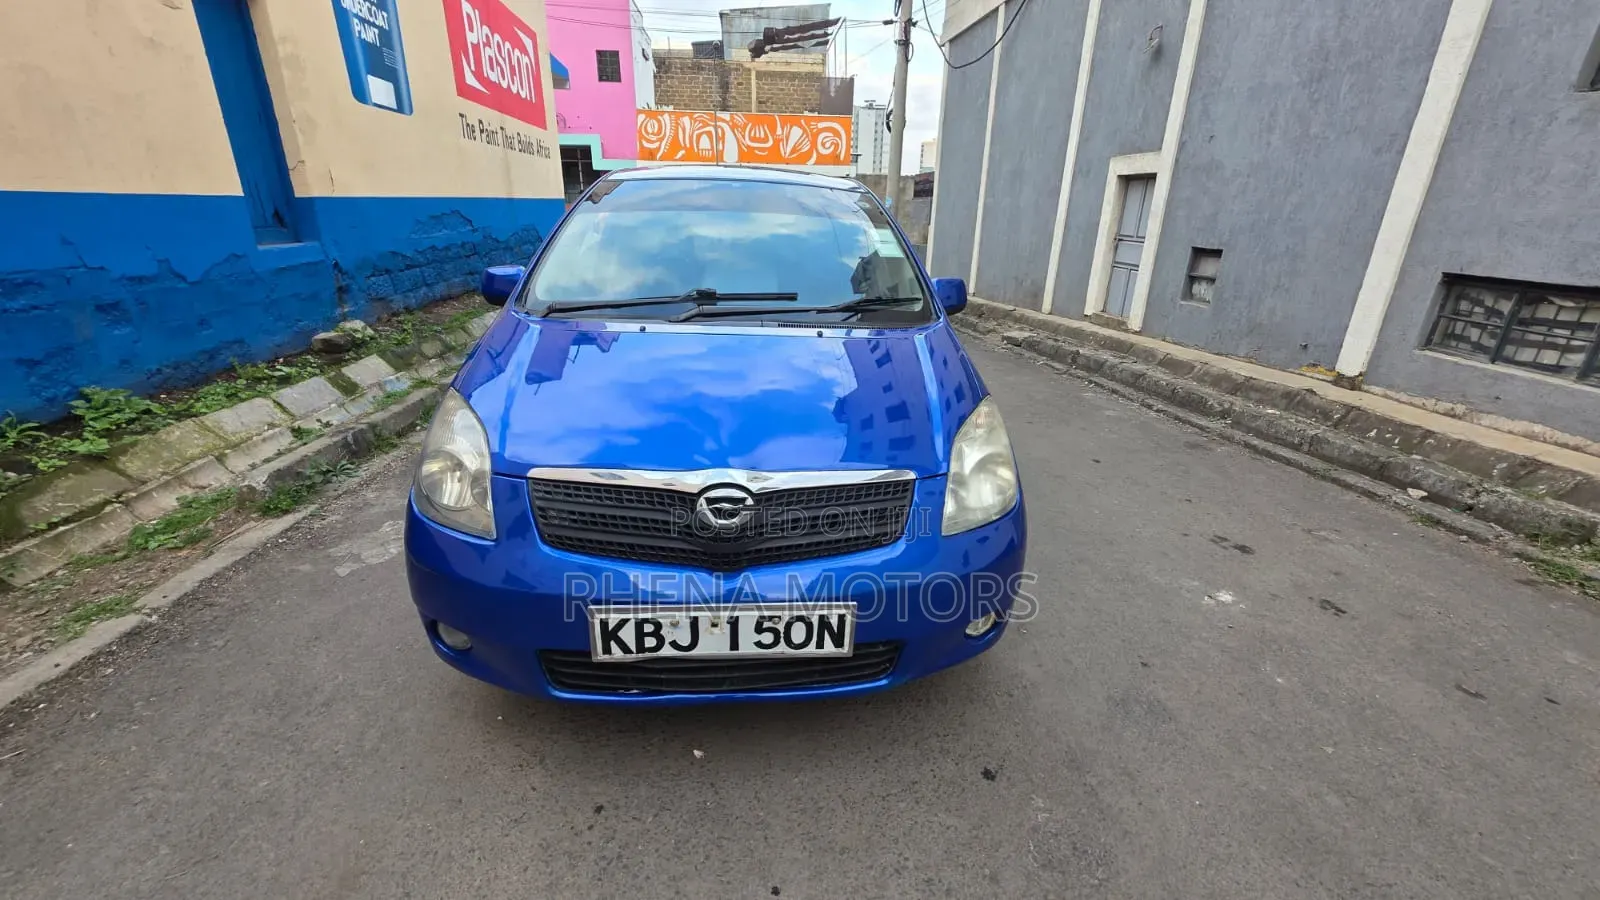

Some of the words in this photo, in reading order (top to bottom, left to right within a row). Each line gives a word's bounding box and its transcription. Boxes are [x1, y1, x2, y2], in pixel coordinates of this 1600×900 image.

[352, 17, 380, 48] PAINT
[462, 3, 535, 103] Plascon
[459, 112, 477, 141] The
[478, 118, 500, 148] Paint
[500, 126, 516, 152] That
[517, 132, 535, 156] Builds
[536, 138, 551, 159] Africa
[600, 615, 700, 655] KBJ
